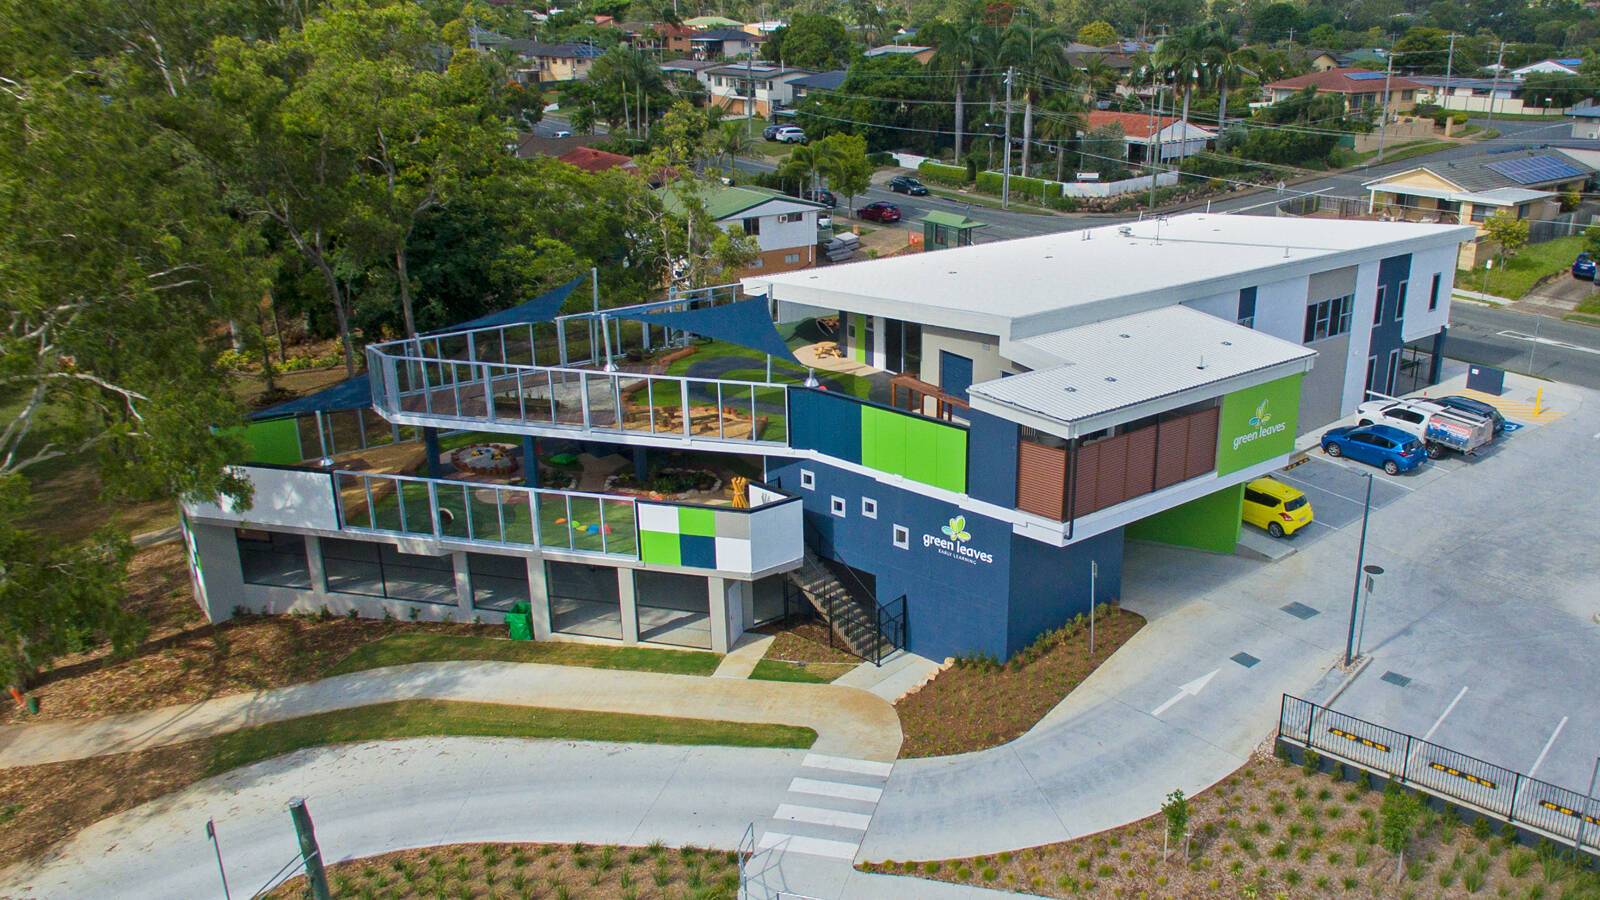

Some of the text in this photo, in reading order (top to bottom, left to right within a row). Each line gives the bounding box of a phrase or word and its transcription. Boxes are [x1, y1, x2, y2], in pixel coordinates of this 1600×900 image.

[1233, 422, 1286, 450] green leaves
[923, 534, 993, 564] green leaves
